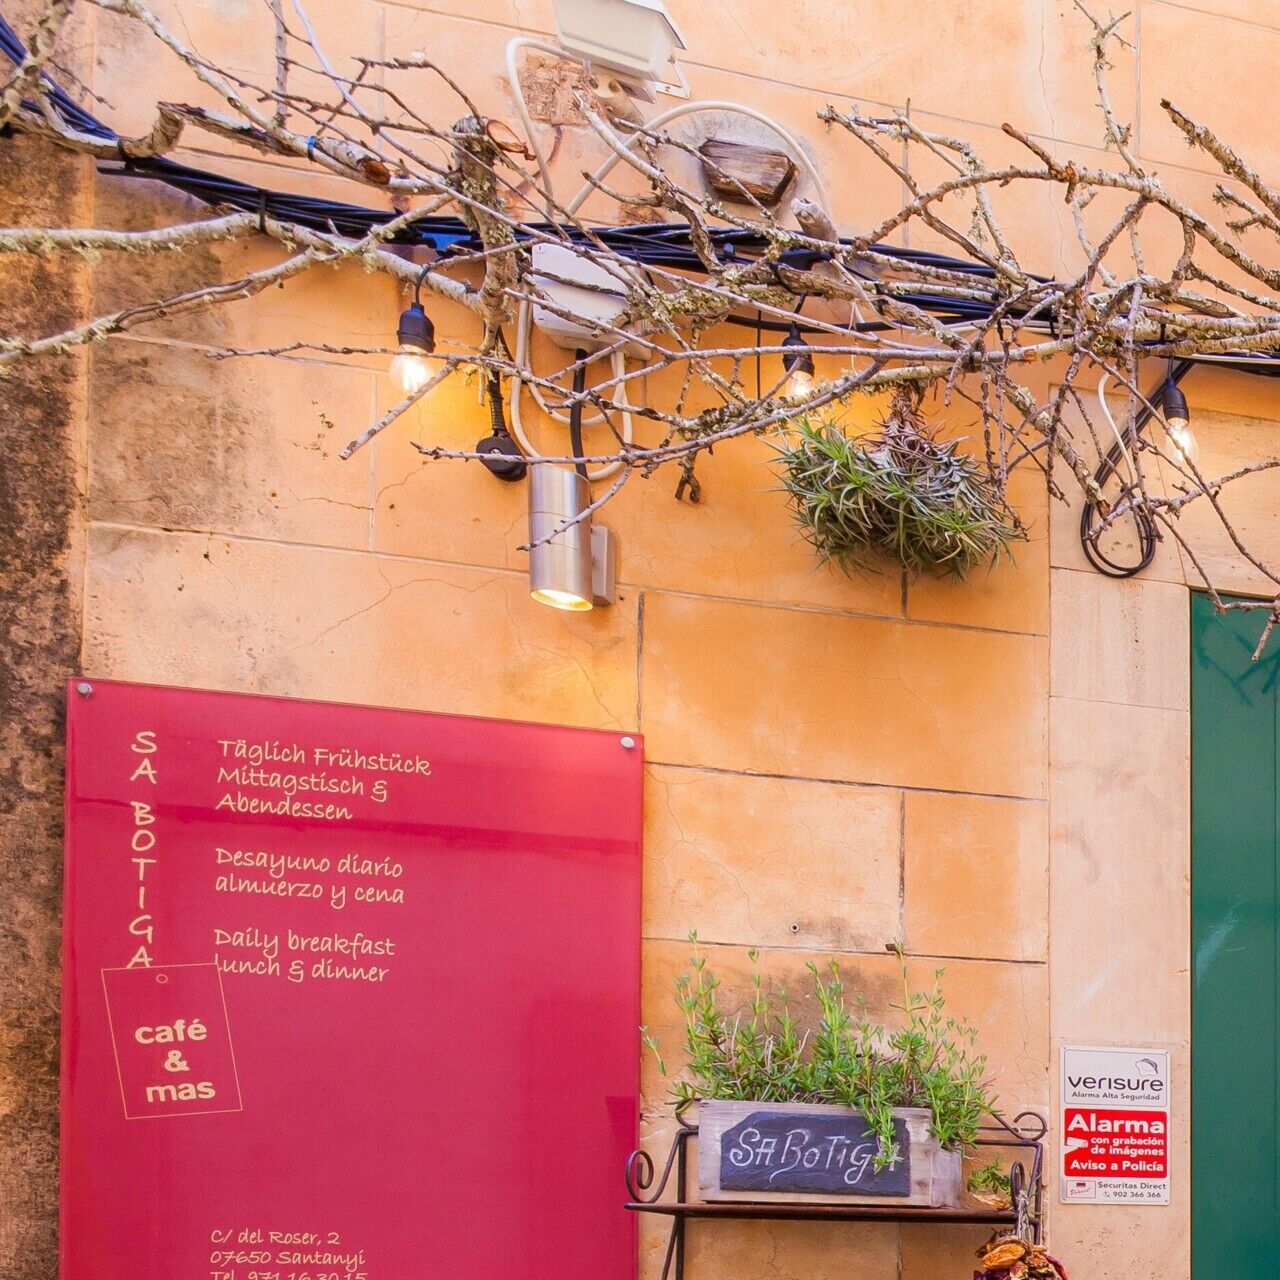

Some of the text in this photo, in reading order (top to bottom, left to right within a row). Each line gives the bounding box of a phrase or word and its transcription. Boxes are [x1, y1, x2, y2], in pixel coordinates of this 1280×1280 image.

[217, 739, 432, 776] Täglich Frühstück
[217, 765, 388, 803] Mittagstisch &
[215, 791, 353, 820] Abendessen
[126, 731, 159, 969] SA BOTIGA
[215, 847, 404, 879] Desayuno diario
[215, 873, 404, 910] almuerzo y cena
[214, 927, 396, 960] Daily breakfast
[287, 959, 304, 983] &
[311, 957, 390, 982] dinner
[134, 1018, 208, 1045] café
[163, 1050, 190, 1073] &
[145, 1081, 216, 1103] mas
[1067, 1075, 1164, 1092] verisure
[1071, 1091, 1100, 1099] Alarma
[1120, 1092, 1160, 1102] Seguridad
[1067, 1113, 1165, 1134] Alarma
[1090, 1136, 1164, 1147] con grabación
[1090, 1145, 1165, 1158] de imágenes
[1070, 1159, 1164, 1172] Aviso a Policía
[1097, 1181, 1167, 1190] Securitas Direct
[210, 1227, 341, 1247] C/ del Roser, 2
[210, 1250, 272, 1267] 07650
